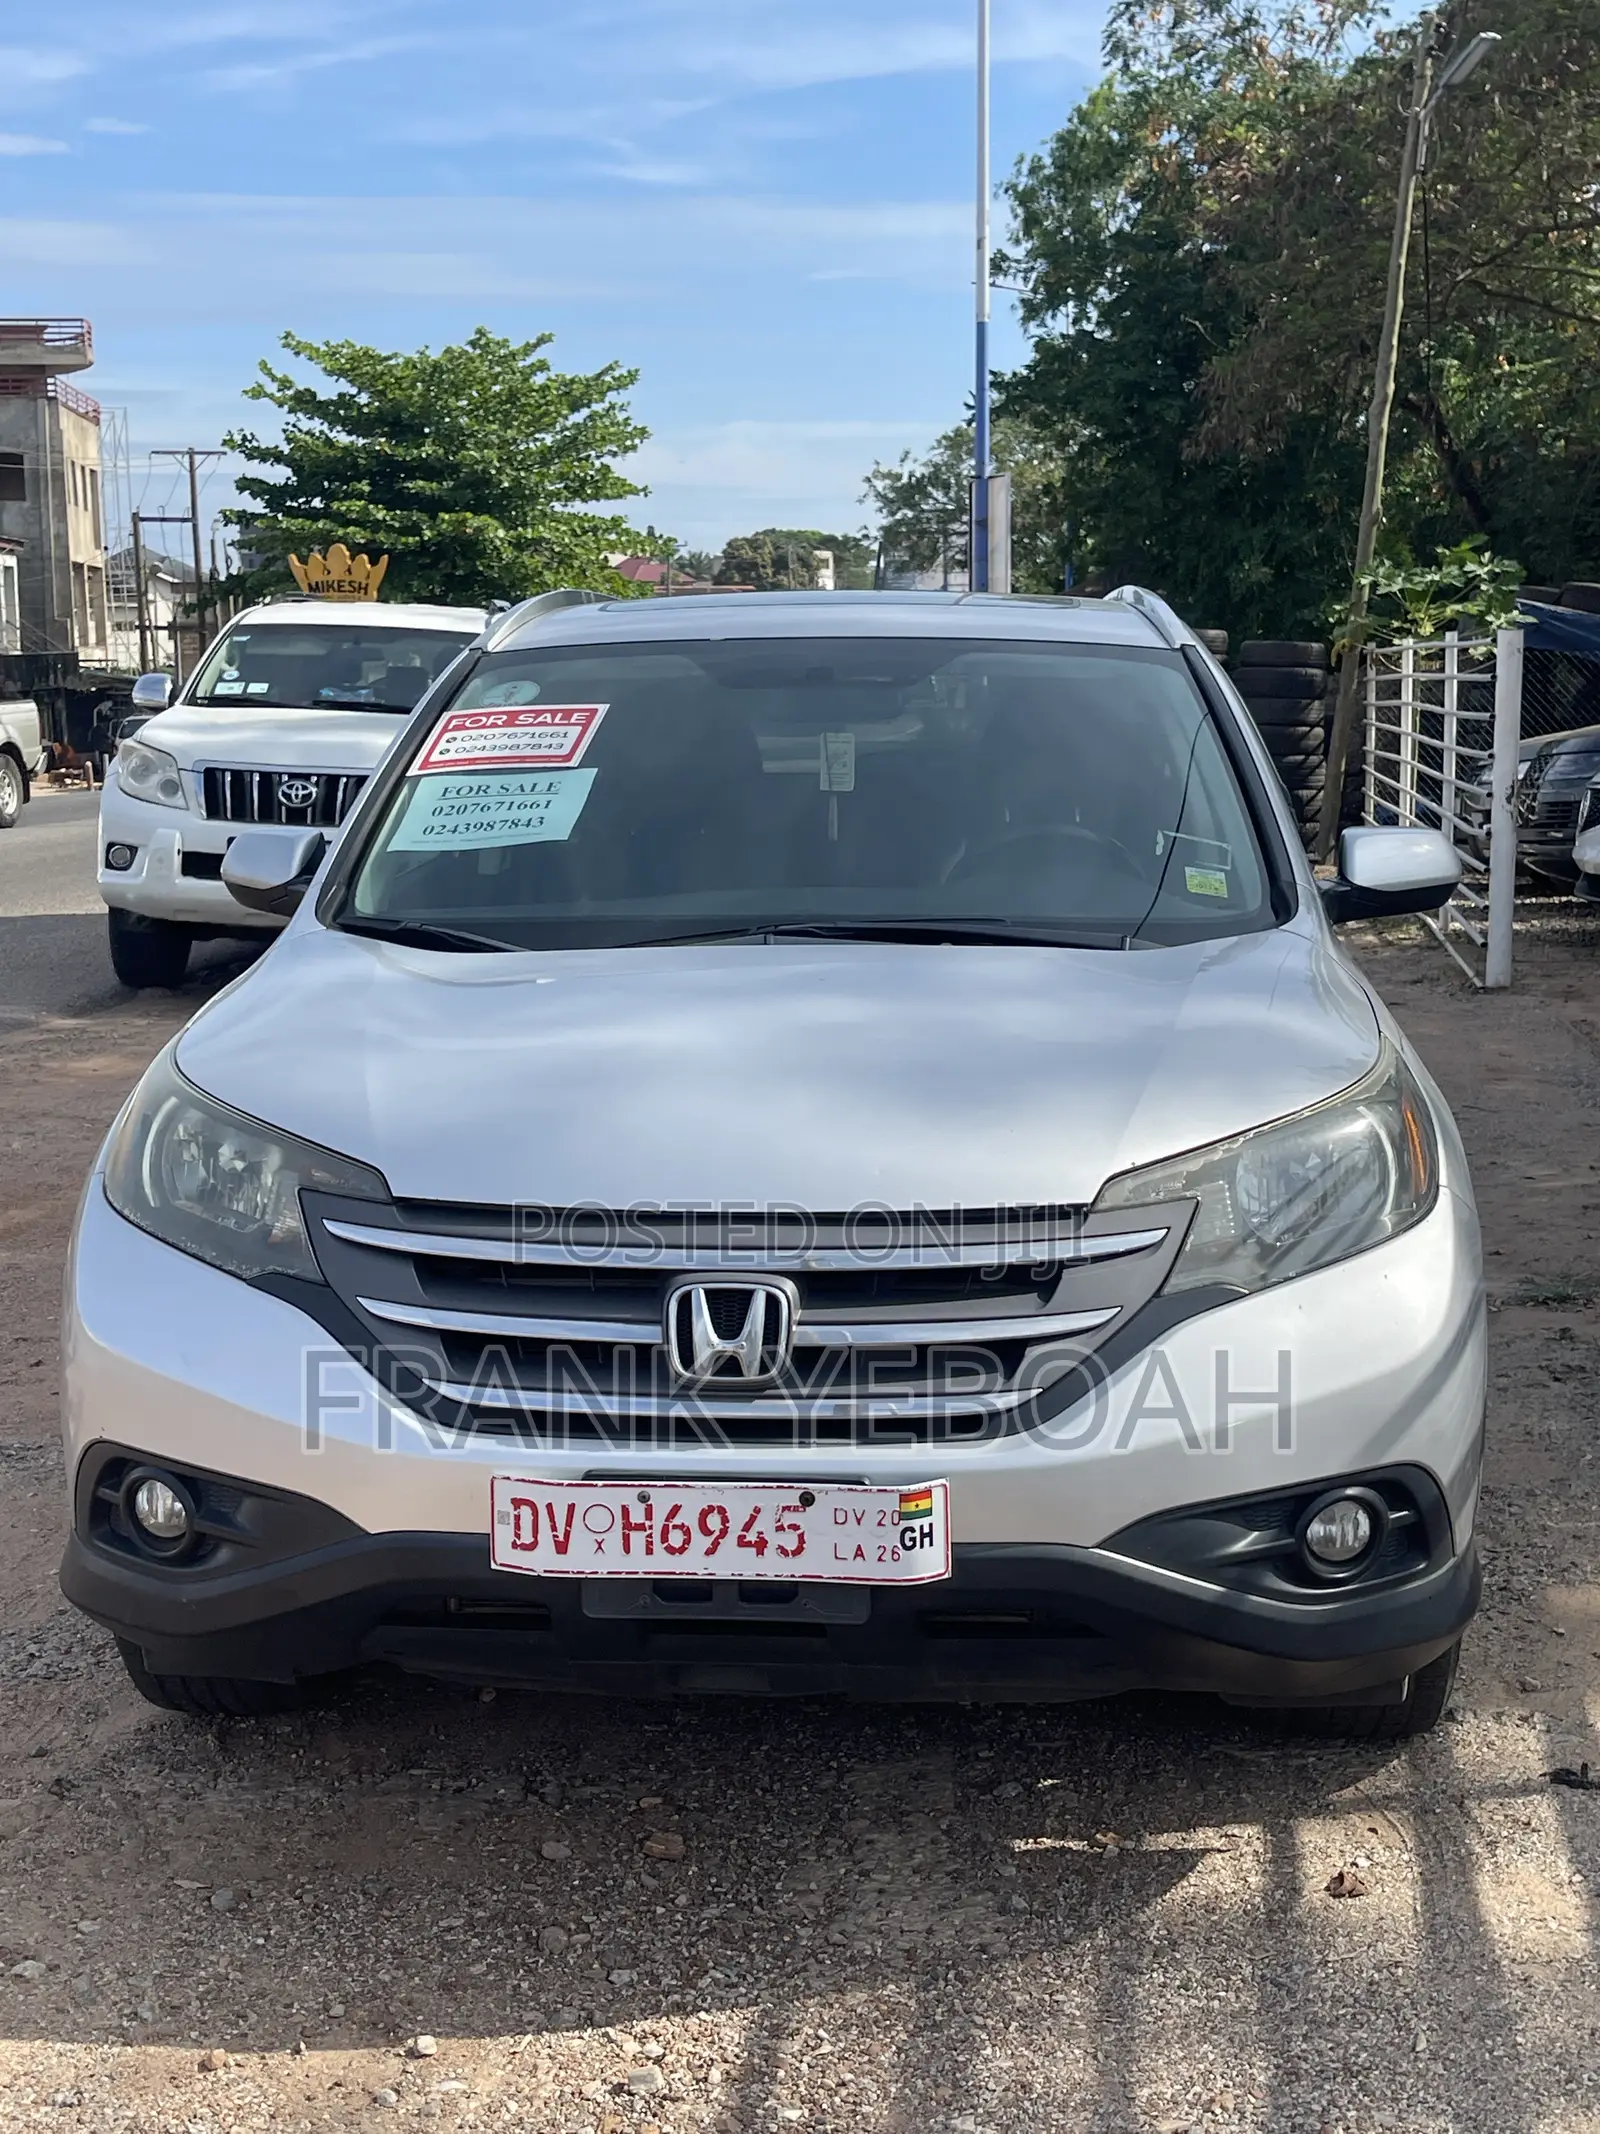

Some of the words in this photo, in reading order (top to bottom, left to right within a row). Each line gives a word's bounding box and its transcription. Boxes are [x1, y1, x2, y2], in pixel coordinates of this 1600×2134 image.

[307, 579, 369, 595] MIKESH
[447, 714, 507, 729] FOR
[514, 712, 590, 725] SALE
[460, 731, 568, 743] 0207671661
[454, 742, 564, 754] 0243987843
[440, 784, 491, 797] FOR
[498, 781, 562, 794] SALE
[431, 800, 552, 817] 0207671661
[422, 816, 545, 836] 0243987843
[833, 1508, 866, 1526] DV
[876, 1509, 901, 1527] 20
[510, 1497, 576, 1555] DV
[620, 1502, 807, 1557] H6945
[900, 1522, 934, 1551] GH
[834, 1543, 867, 1562] LA
[876, 1544, 901, 1562] 26
